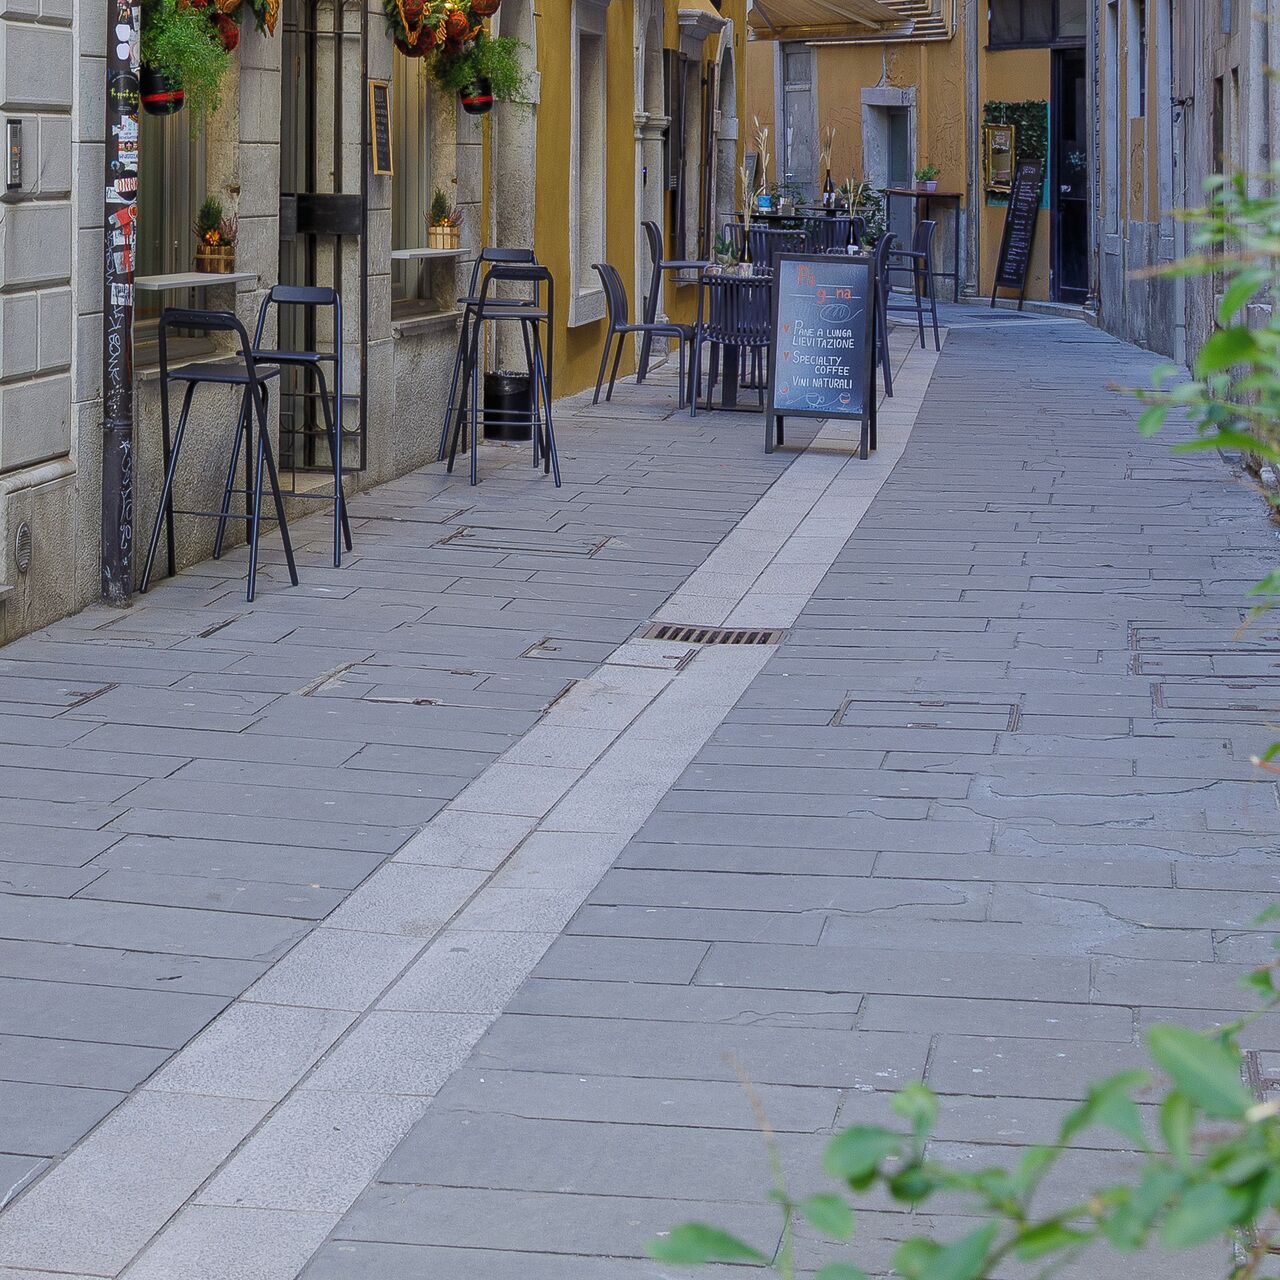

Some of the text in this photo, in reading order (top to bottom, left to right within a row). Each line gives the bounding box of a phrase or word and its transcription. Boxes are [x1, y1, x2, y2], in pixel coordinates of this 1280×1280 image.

[794, 320, 852, 338] PANE A LUNGA
[792, 336, 855, 349] LIEVITAZIONE
[792, 350, 842, 366] SPECIALTY
[814, 365, 850, 376] COFFEE
[792, 375, 853, 389] VINI NATURALI
